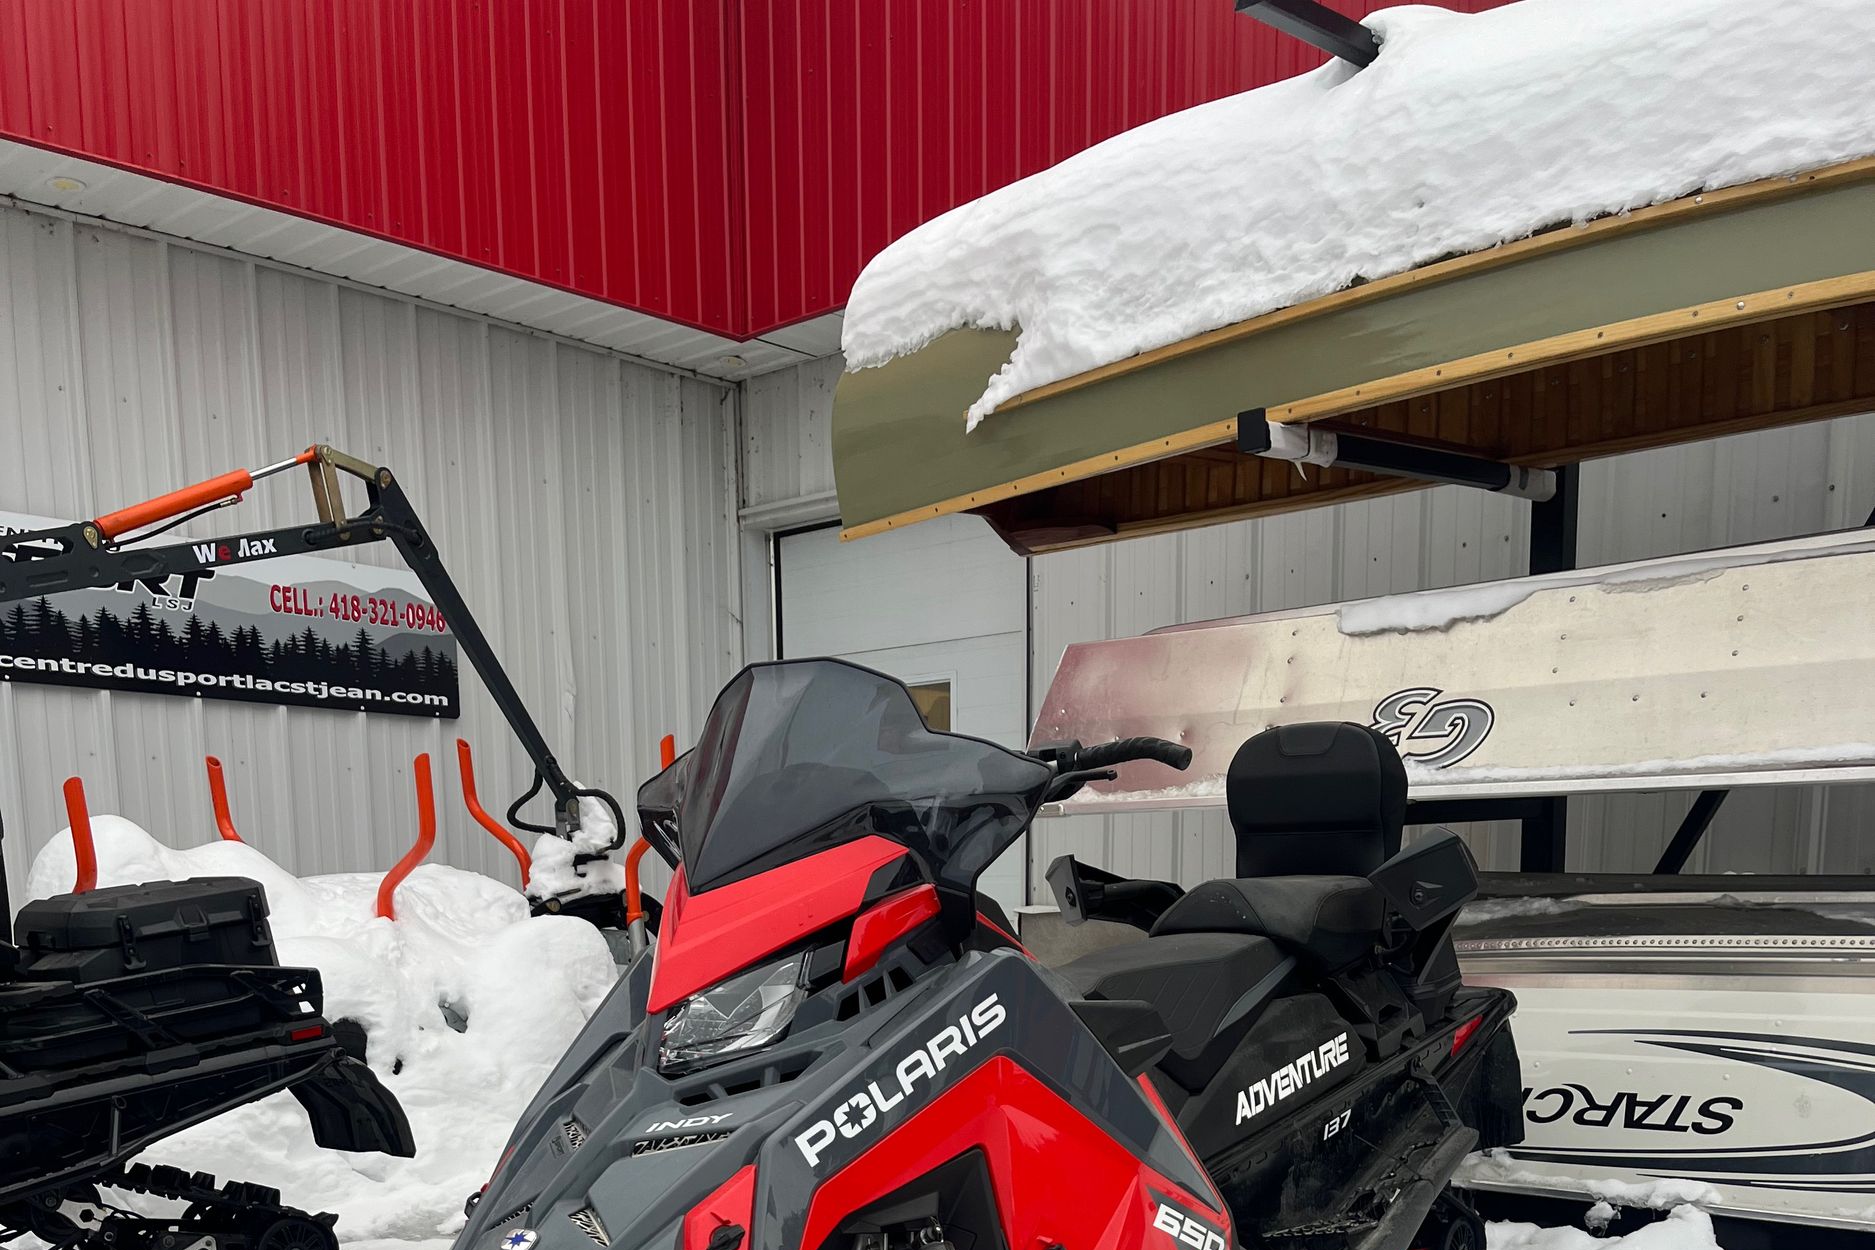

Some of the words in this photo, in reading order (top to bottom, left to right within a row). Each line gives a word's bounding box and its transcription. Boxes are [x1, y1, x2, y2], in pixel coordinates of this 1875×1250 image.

[269, 584, 323, 618] CELL.:
[328, 592, 447, 634] 418-321-0946
[0, 654, 448, 706] centredusportlacstjean.com
[795, 992, 1006, 1167] POLARIS
[1235, 1032, 1350, 1126] ADVENTURE
[645, 1113, 733, 1133] INDY
[1323, 1108, 1352, 1141] 137
